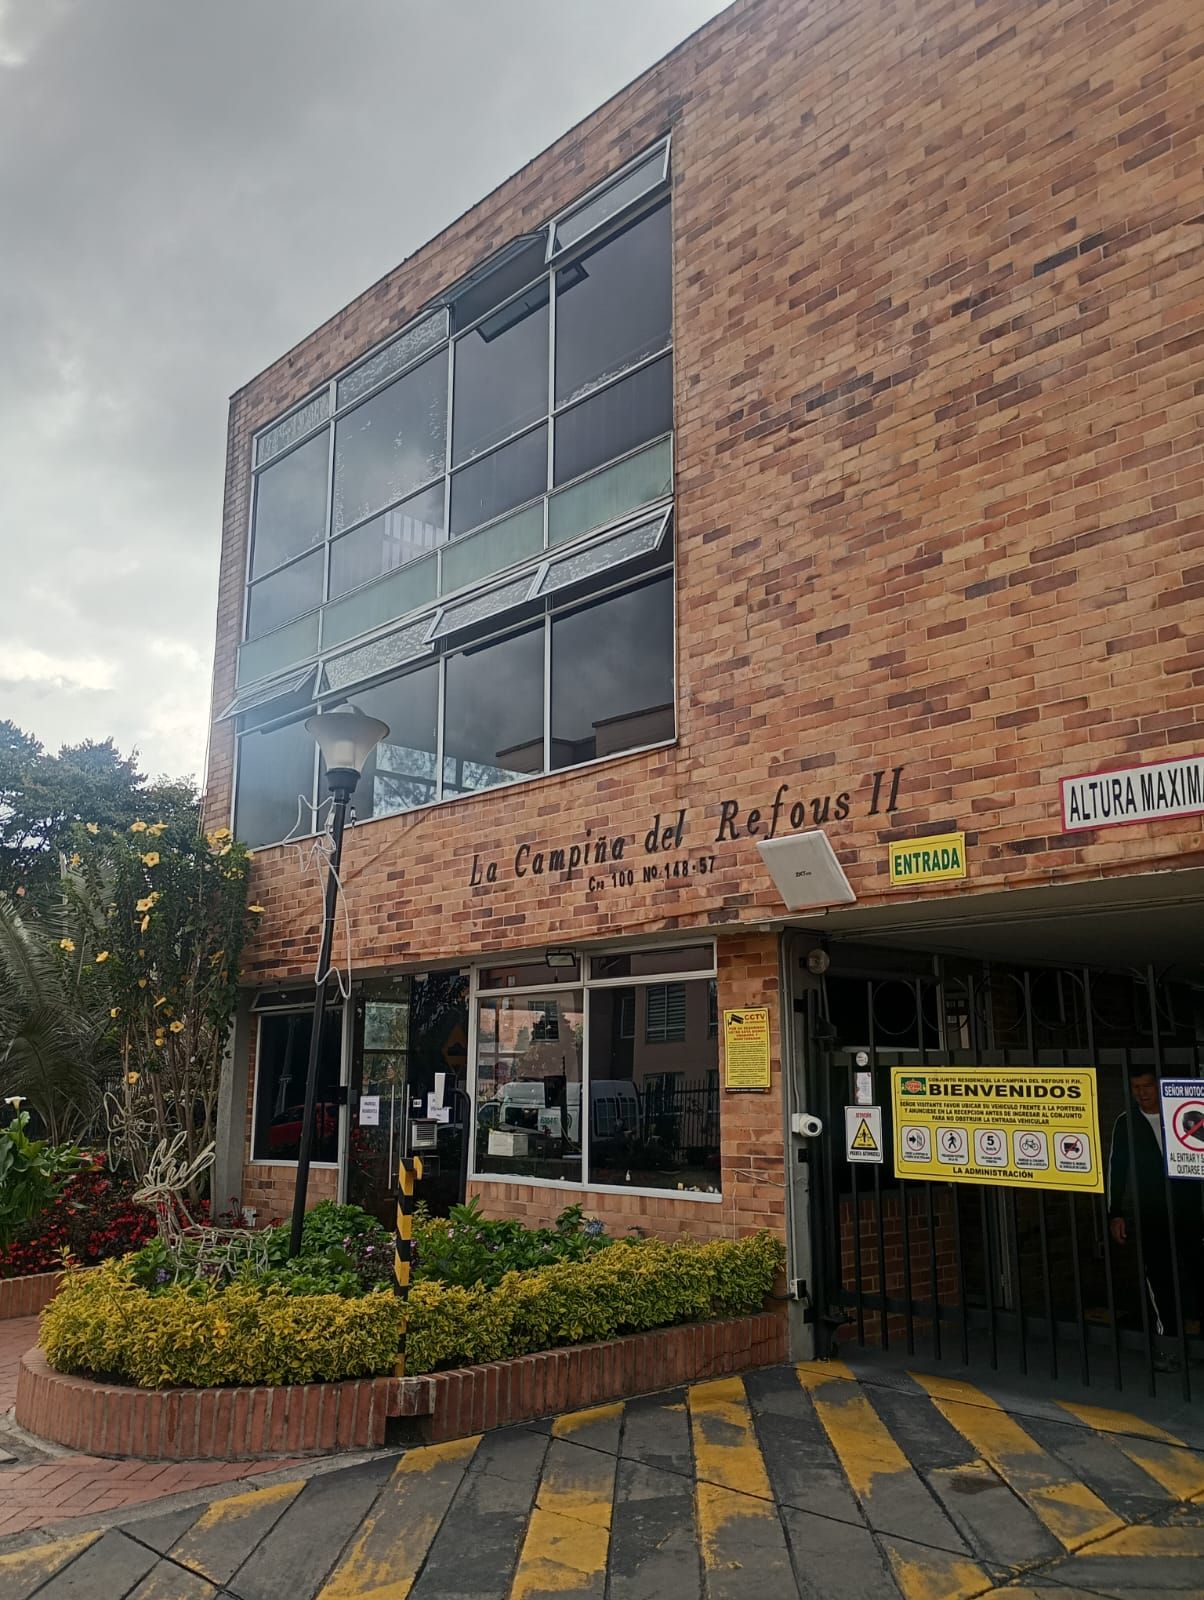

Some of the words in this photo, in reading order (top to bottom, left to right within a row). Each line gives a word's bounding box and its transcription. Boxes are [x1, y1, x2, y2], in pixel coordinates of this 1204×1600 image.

[1070, 775, 1138, 822] ALTURA
[1140, 764, 1204, 811] MAXIM
[469, 853, 498, 887] La
[514, 828, 626, 881] Campiña
[644, 808, 687, 853] del
[714, 783, 850, 842] Refous
[867, 767, 904, 815] II
[894, 847, 961, 876] ENTRADA
[611, 869, 634, 888] 100
[929, 1083, 1082, 1099] BIENVENIDOS
[1164, 1083, 1184, 1097] SEÑOR
[986, 1135, 995, 1146] 5
[1170, 1151, 1176, 1162] AL
[1177, 1152, 1196, 1163] ENTRAR
[1196, 1153, 1200, 1163] Y
[953, 1166, 962, 1174] LA
[964, 1167, 1034, 1179] ADMINISTRACIÓN
[1177, 1164, 1200, 1175] QUITARSE
